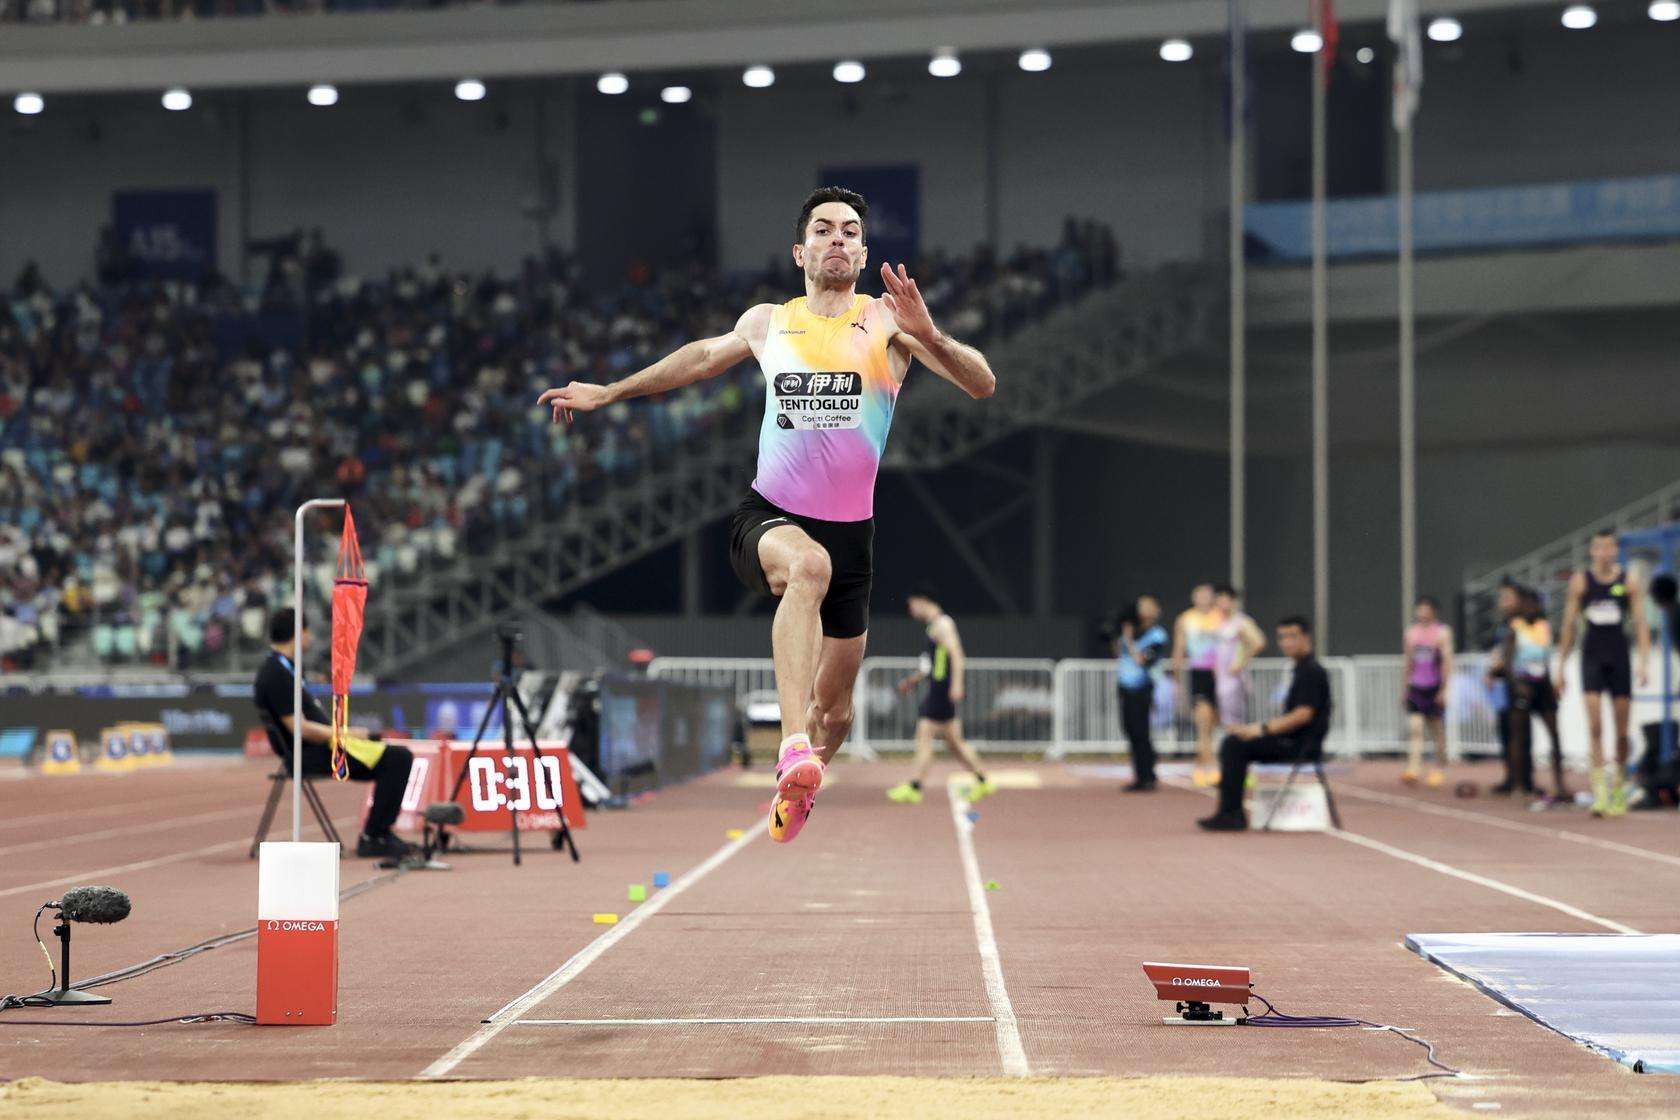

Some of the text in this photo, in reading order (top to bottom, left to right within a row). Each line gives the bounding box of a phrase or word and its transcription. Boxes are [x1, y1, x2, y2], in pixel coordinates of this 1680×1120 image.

[807, 374, 853, 393] 伊利
[779, 399, 859, 410] TENTOGLOU
[469, 756, 563, 811] 0:30
[283, 921, 325, 931] OMEGA
[1184, 978, 1221, 987] OMEGA
